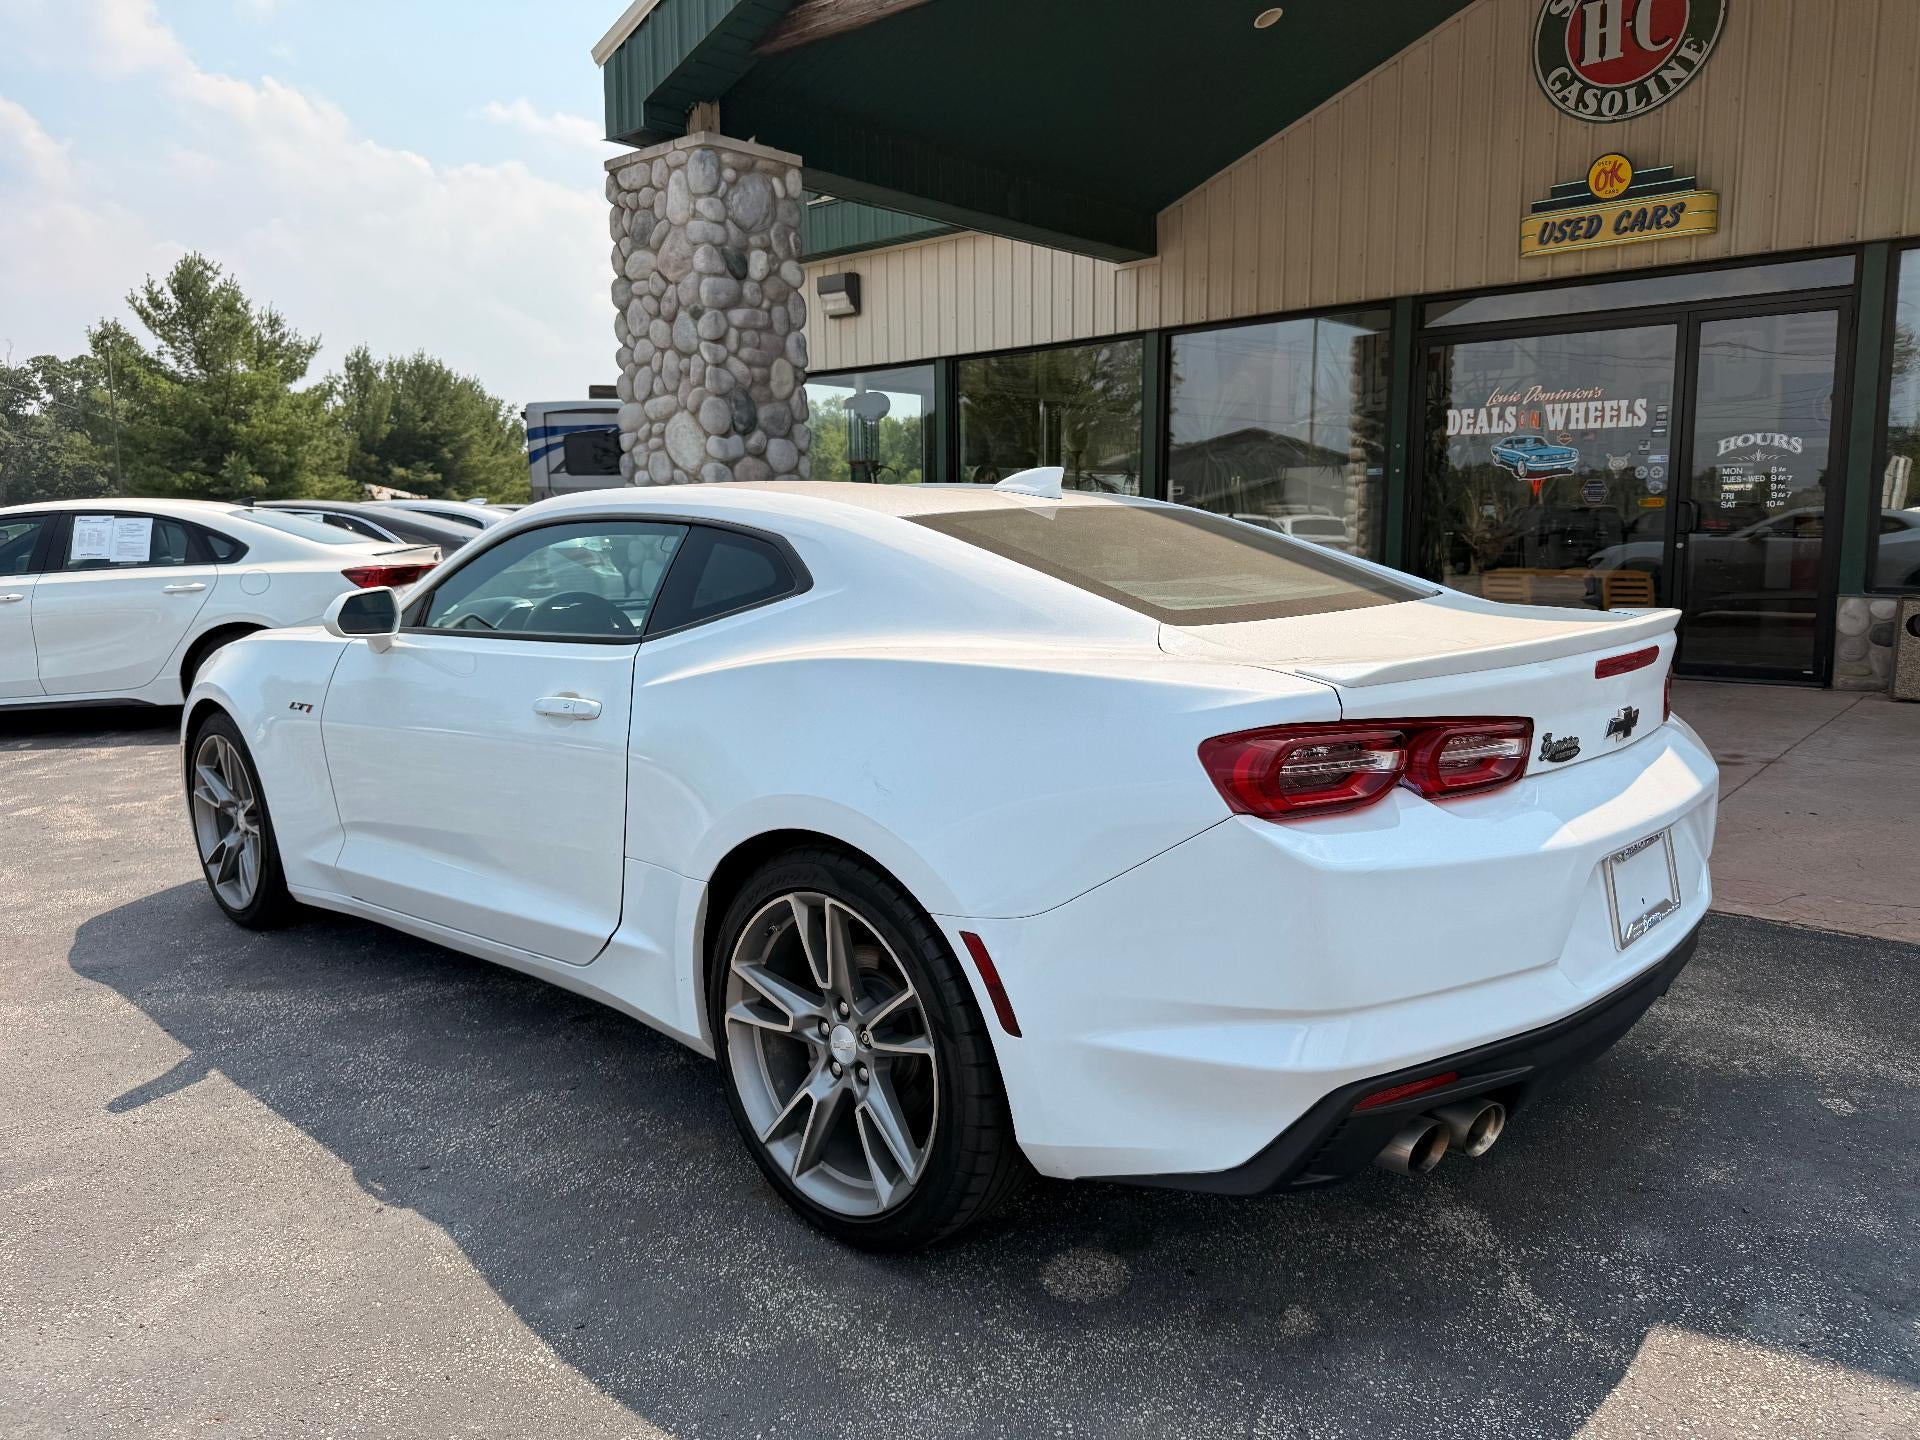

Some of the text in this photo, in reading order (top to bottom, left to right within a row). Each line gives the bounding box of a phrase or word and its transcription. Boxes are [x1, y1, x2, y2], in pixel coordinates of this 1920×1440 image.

[1547, 36, 1709, 117] GASOLINE
[1594, 159, 1626, 192] OK
[1537, 201, 1687, 246] USED CARS
[1486, 384, 1604, 407] Louie Dominion's
[1446, 406, 1517, 436] DEALS
[1544, 398, 1648, 431] WHEELS
[1716, 432, 1803, 456] HOURS
[1722, 467, 1743, 475] MON
[1771, 466, 1777, 474] 8
[1720, 501, 1737, 509] SAT
[1766, 500, 1776, 508] 10
[1721, 492, 1735, 500] FRI
[1771, 491, 1778, 499] 9
[289, 701, 314, 714] LT1
